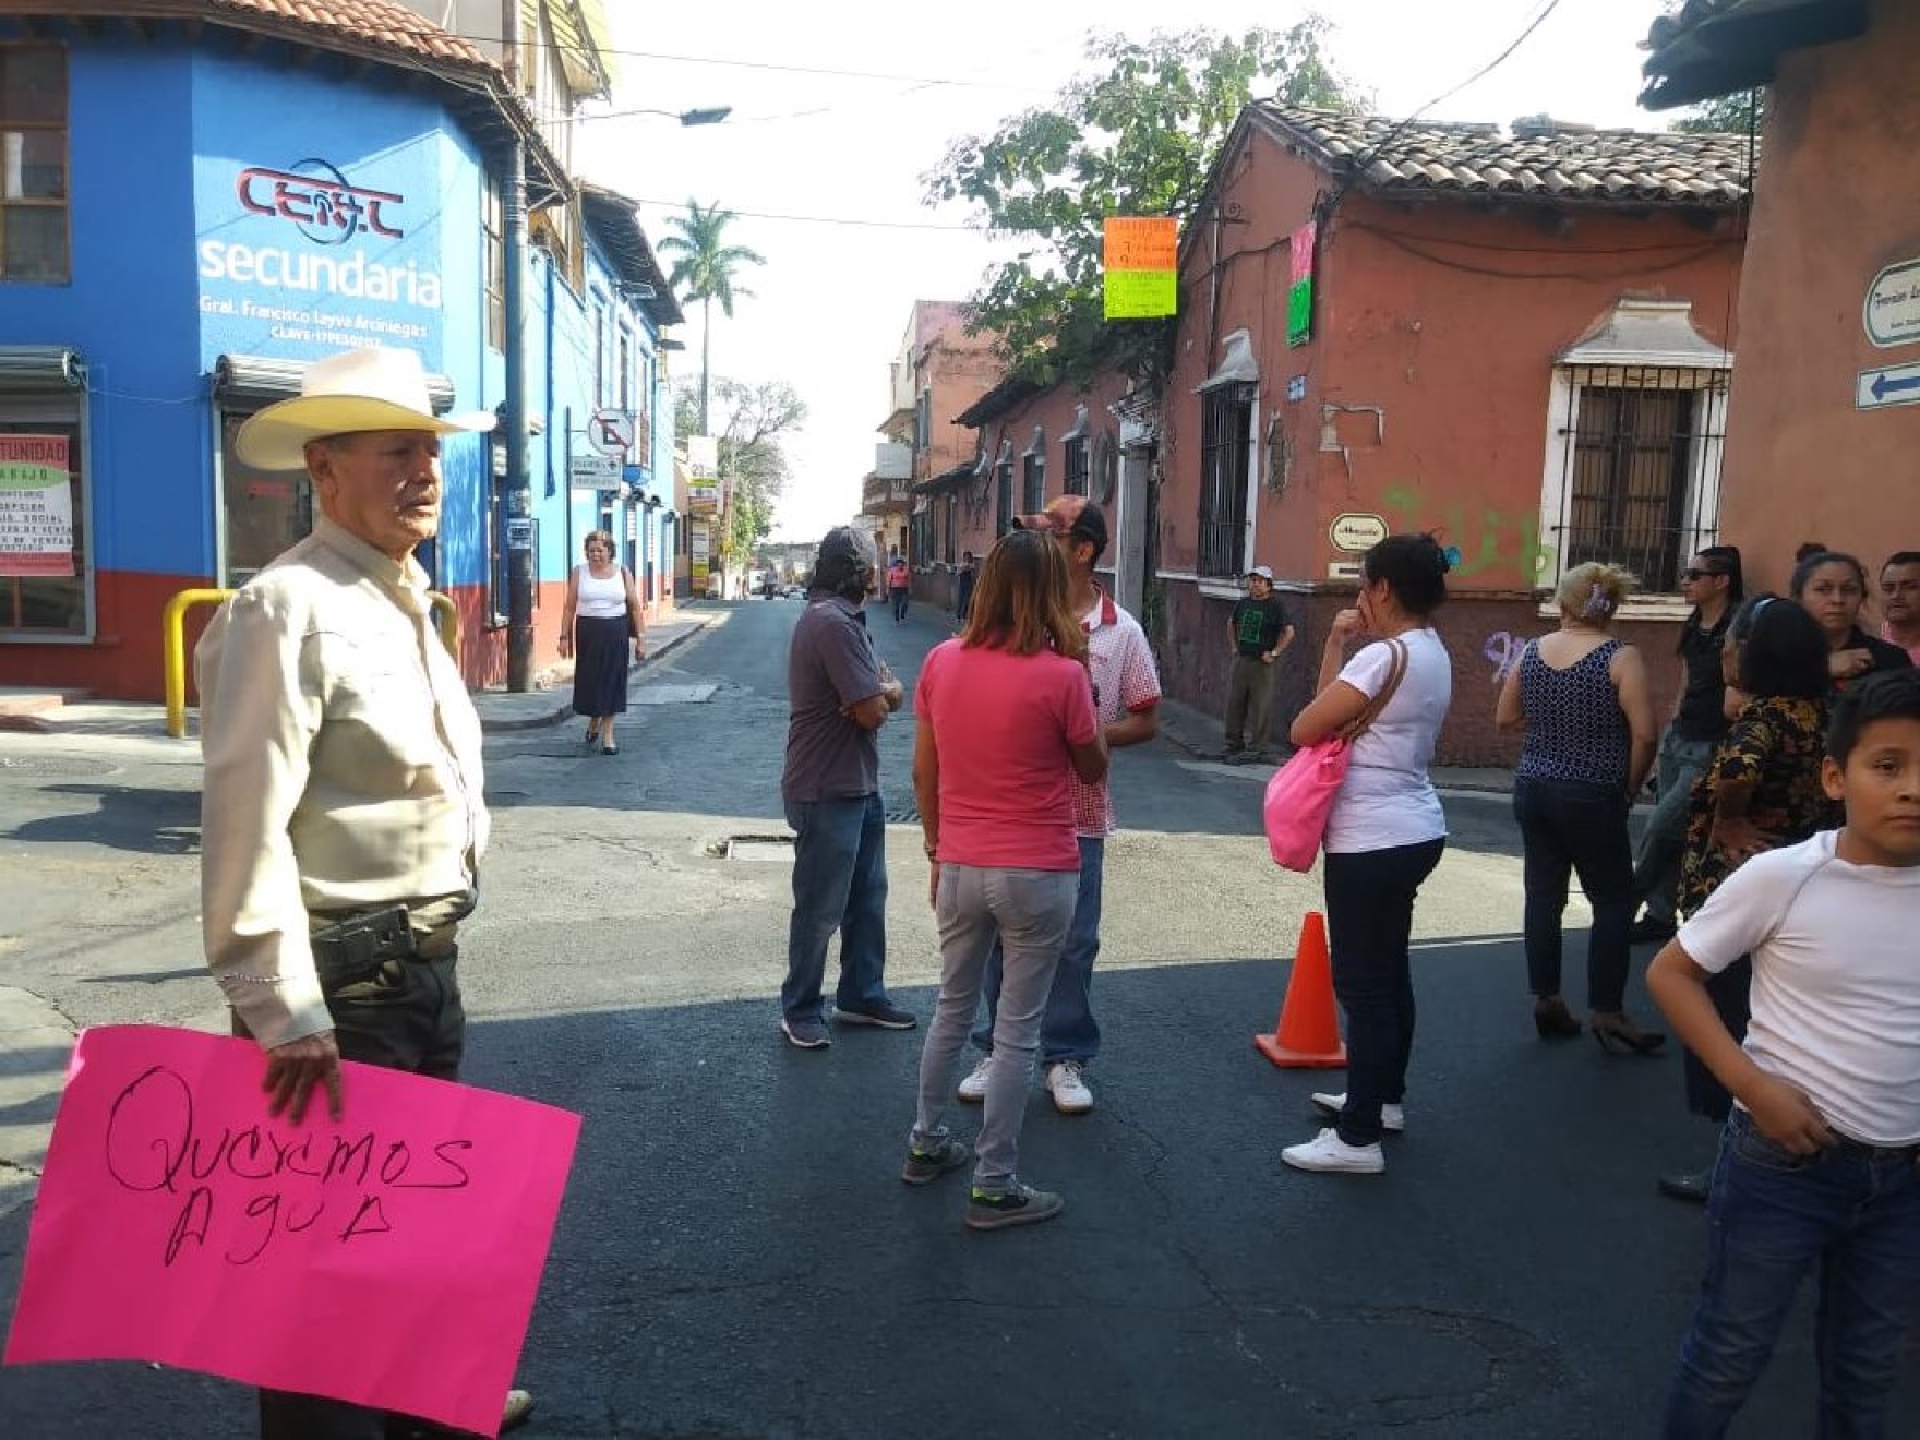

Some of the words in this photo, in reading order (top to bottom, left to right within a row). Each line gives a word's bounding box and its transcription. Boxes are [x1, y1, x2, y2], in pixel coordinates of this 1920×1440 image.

[199, 238, 442, 309] secundaria
[199, 296, 240, 314] Gral.
[243, 301, 310, 324] Francisco
